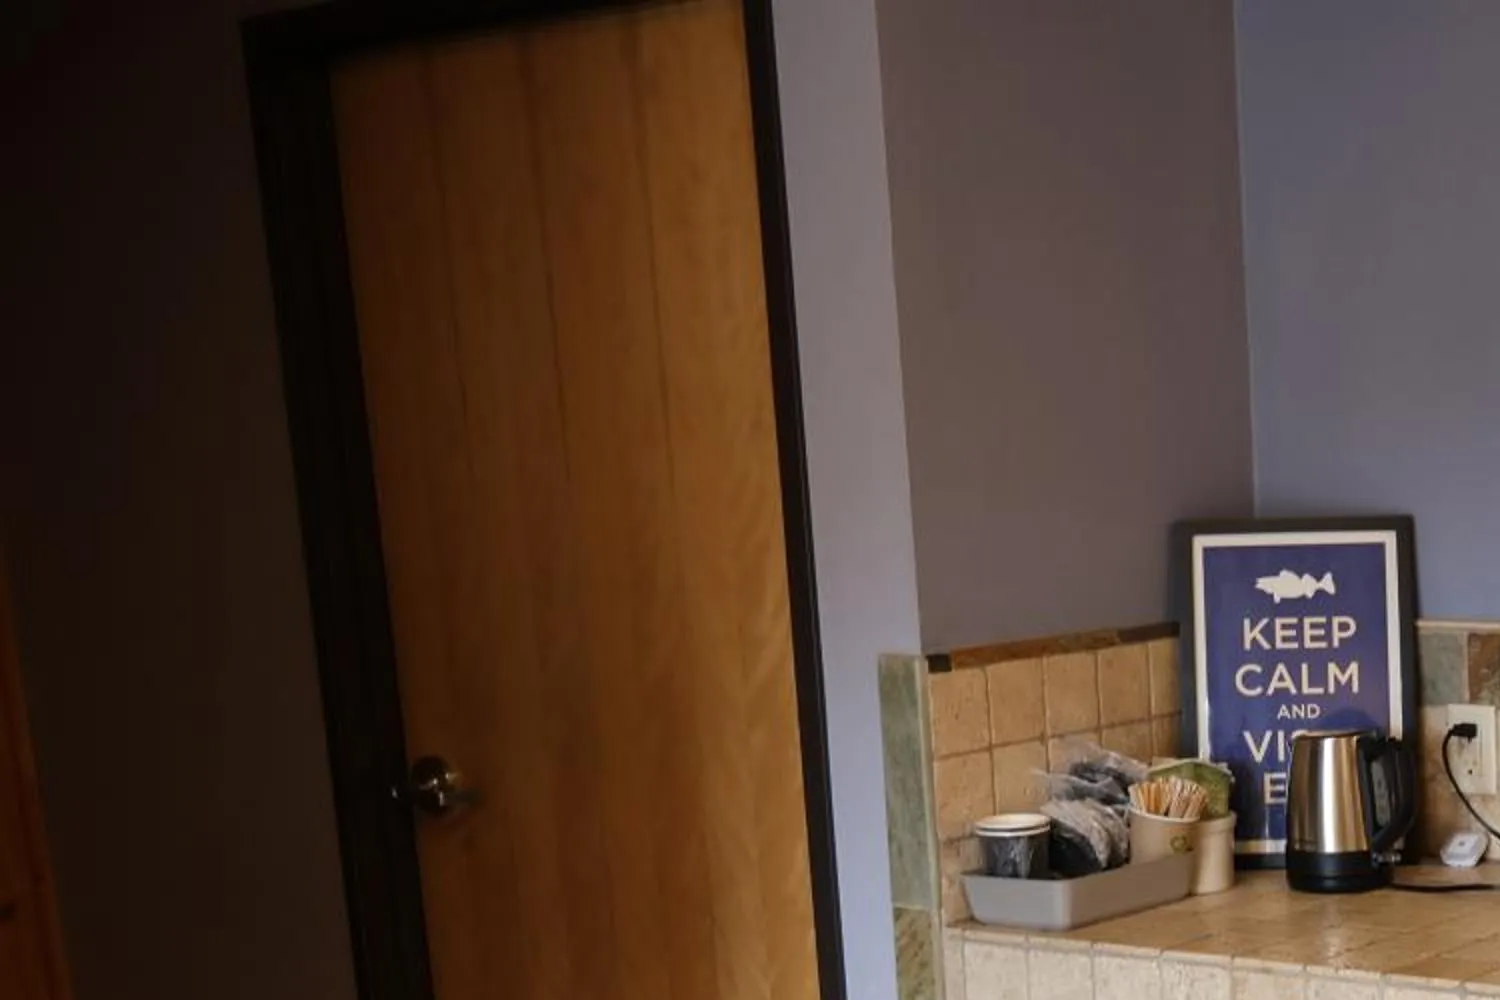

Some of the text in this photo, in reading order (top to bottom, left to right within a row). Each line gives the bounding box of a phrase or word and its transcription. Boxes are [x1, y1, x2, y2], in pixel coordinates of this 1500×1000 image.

[1243, 616, 1357, 651] KEEP
[1234, 661, 1360, 697] CALM
[1277, 704, 1321, 720] AND
